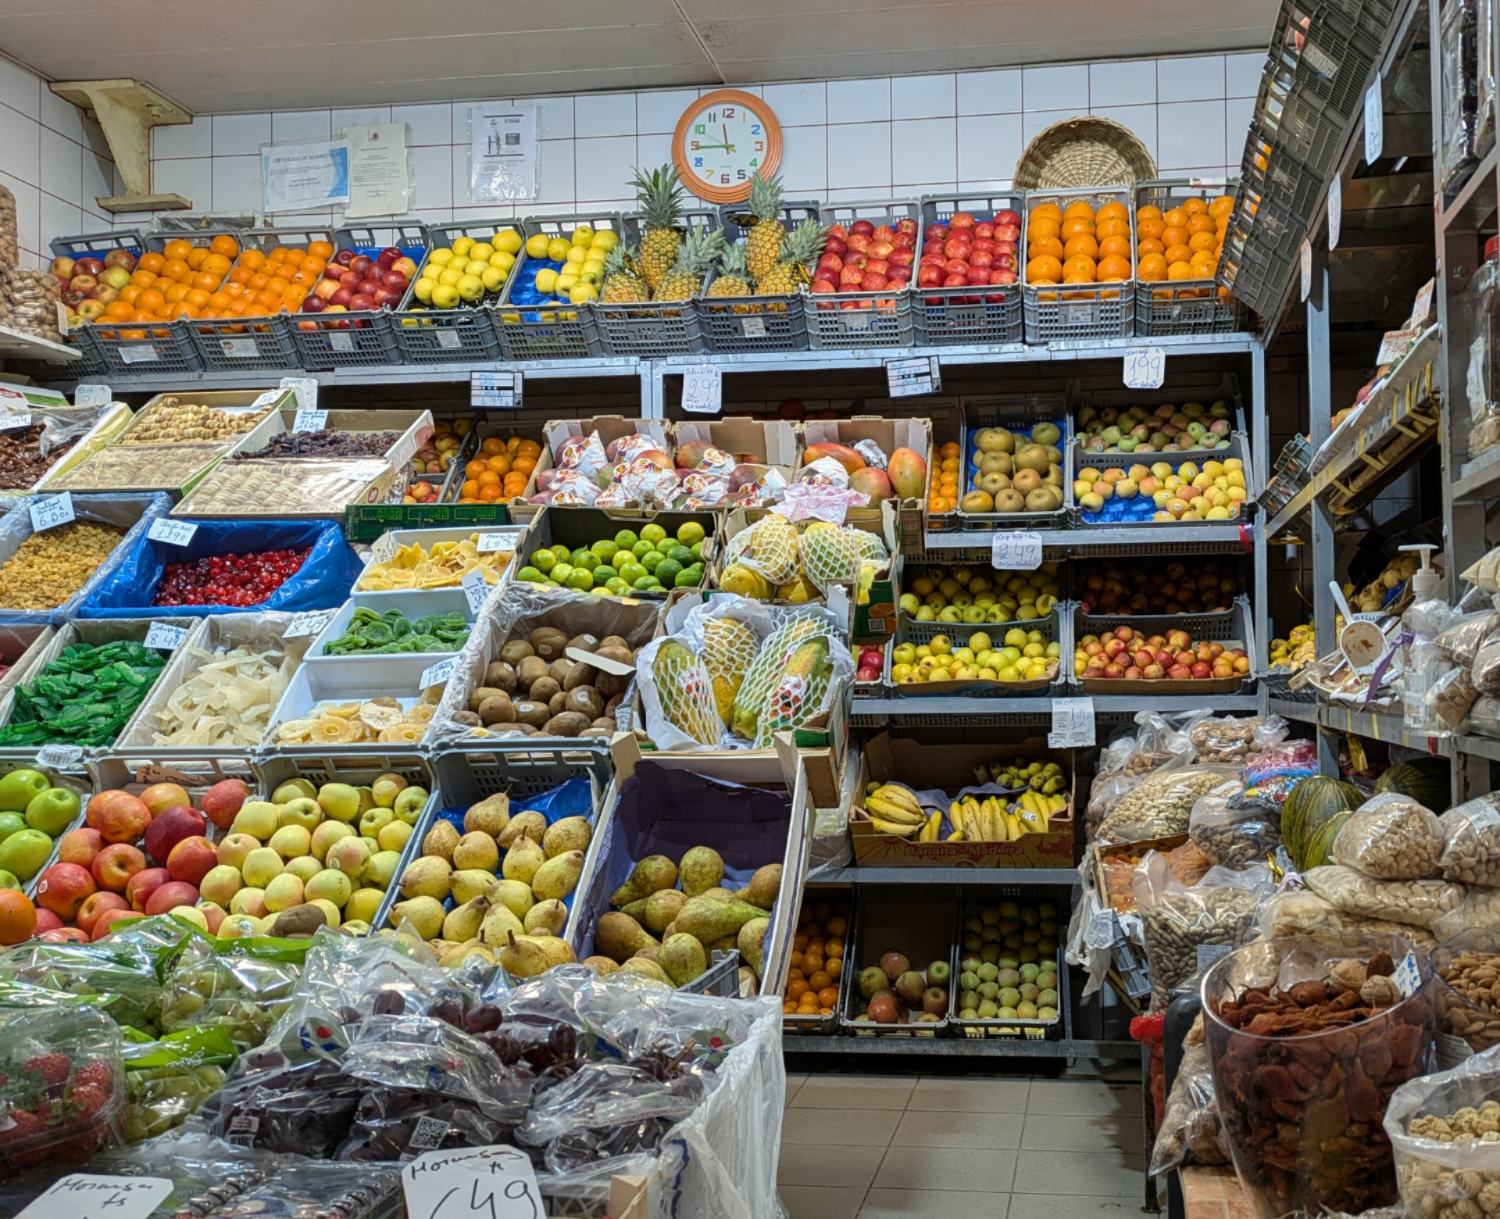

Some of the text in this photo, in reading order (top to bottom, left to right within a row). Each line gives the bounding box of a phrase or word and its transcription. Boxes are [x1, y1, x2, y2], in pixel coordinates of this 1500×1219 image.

[708, 112, 716, 123] 11
[722, 108, 735, 119] 12
[695, 124, 706, 135] 10
[751, 124, 760, 135] 2
[691, 140, 700, 151] 9
[755, 141, 763, 152] 3
[694, 157, 703, 168] 8
[749, 157, 758, 168] 4
[705, 169, 714, 180] 7
[720, 174, 730, 184] 6
[737, 169, 746, 180] 5
[905, 844, 957, 855] Banana
[969, 842, 1025, 855] Madeira
